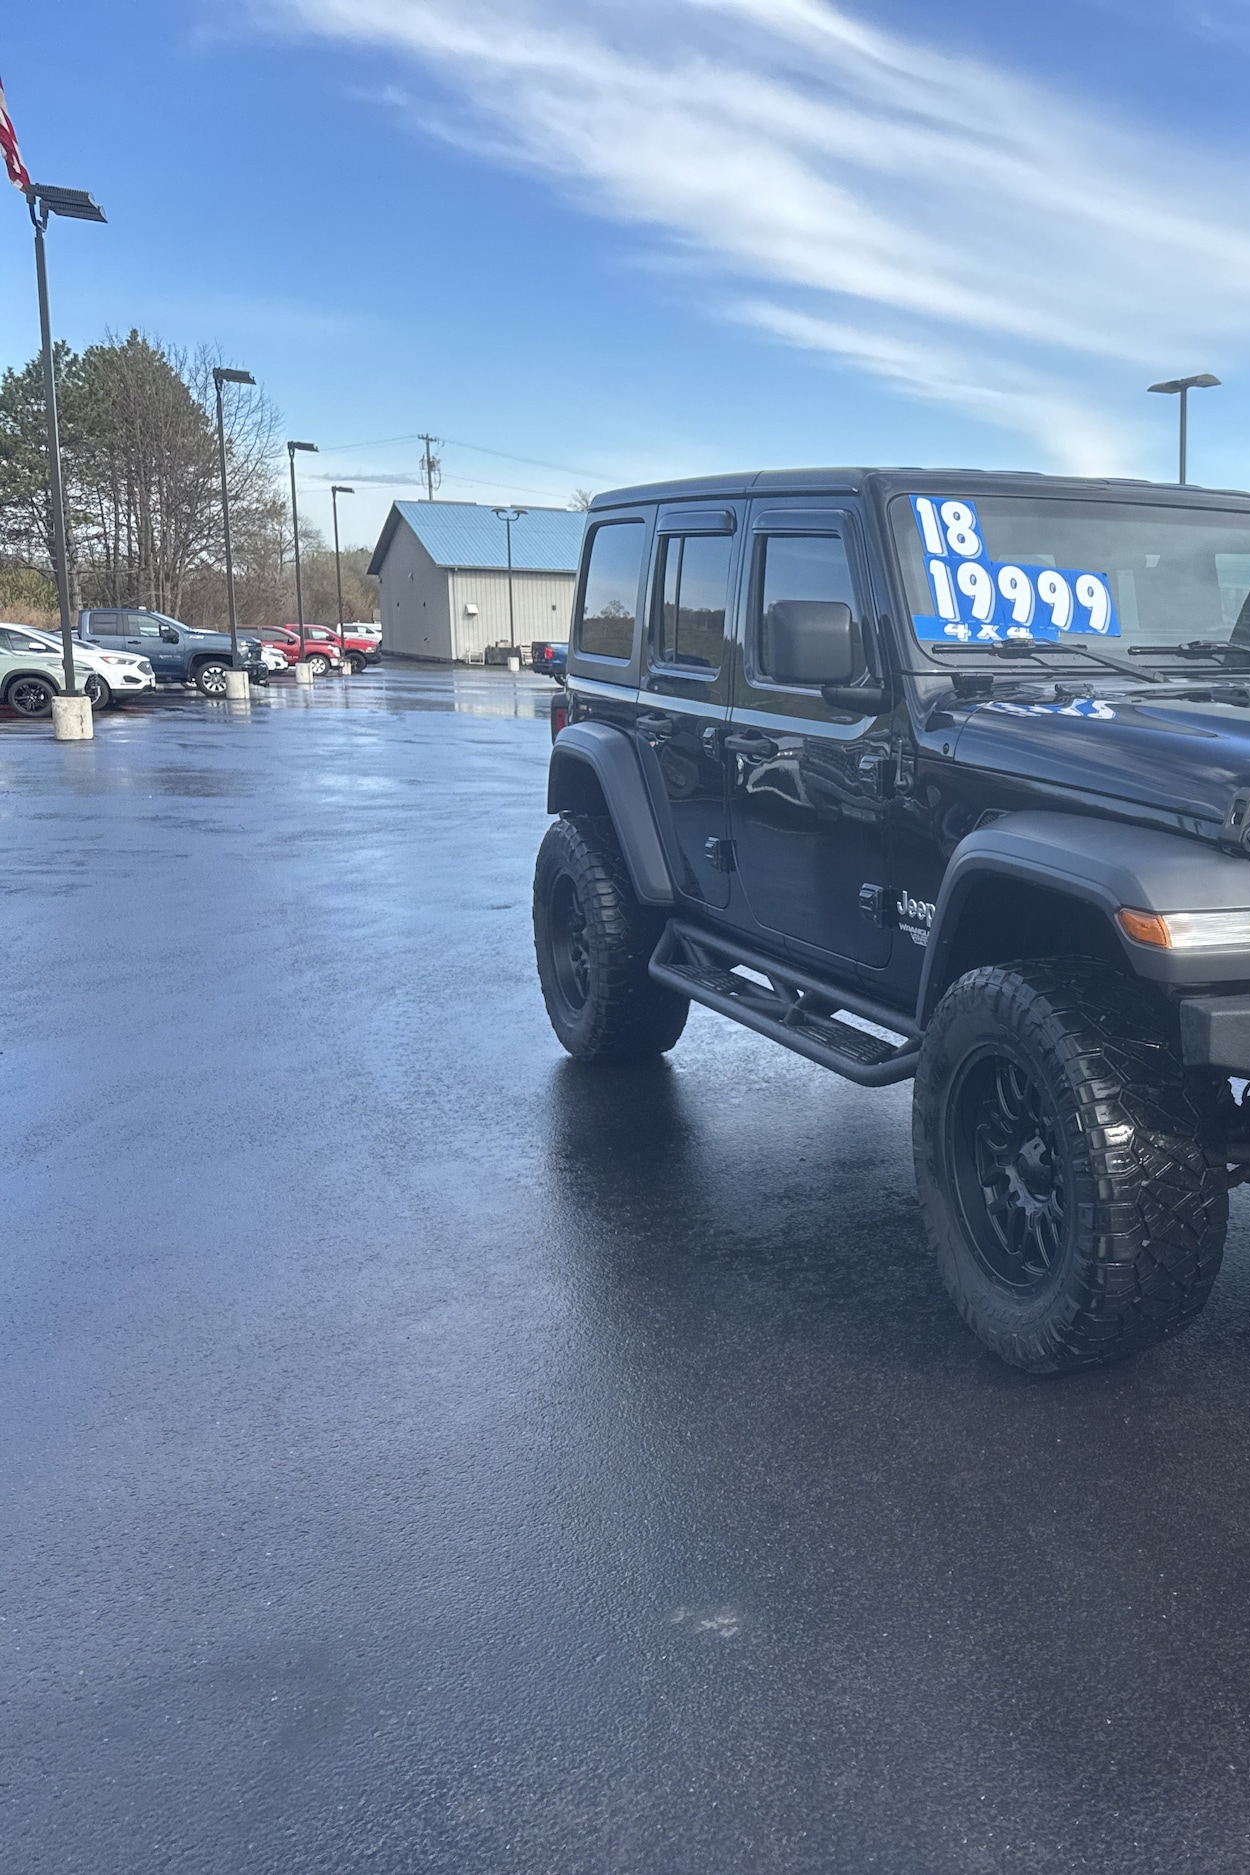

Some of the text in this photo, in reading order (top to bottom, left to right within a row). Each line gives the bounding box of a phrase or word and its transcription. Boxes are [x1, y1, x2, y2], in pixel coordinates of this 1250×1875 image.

[916, 497, 983, 559] 18
[929, 559, 1112, 634] 19999
[896, 890, 936, 928] Jeep
